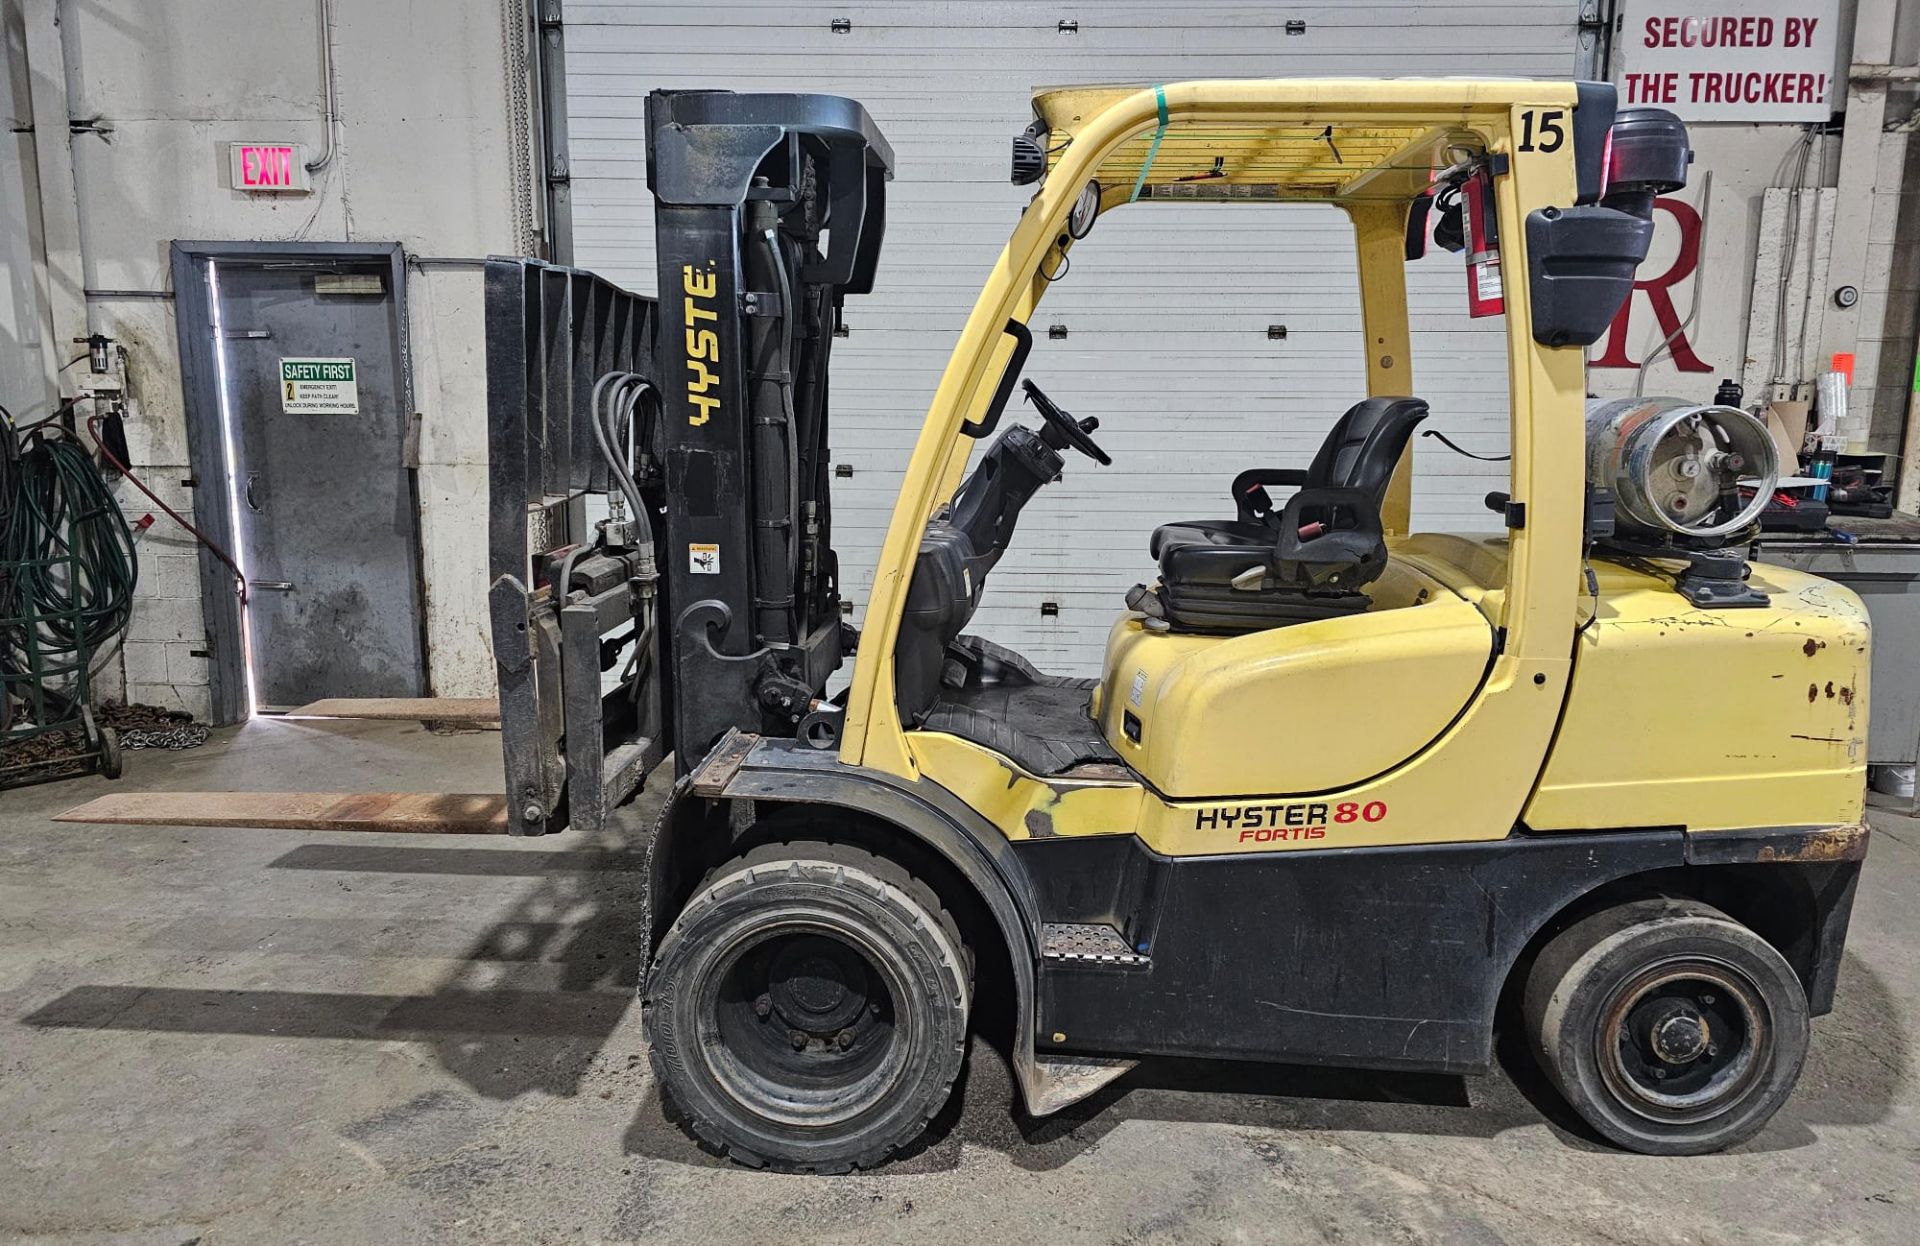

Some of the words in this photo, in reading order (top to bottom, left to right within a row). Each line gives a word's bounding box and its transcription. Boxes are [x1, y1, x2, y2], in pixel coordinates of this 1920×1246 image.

[1643, 16, 1774, 49] SECURED
[1783, 16, 1819, 48] BY
[1625, 72, 1679, 104] THE
[1689, 72, 1826, 105] TRUCKER!
[1518, 110, 1564, 153] 15
[240, 146, 292, 186] EXIT
[284, 364, 321, 379] SAFETY
[323, 364, 351, 379] FIRST
[287, 383, 294, 400] 2
[1195, 802, 1329, 830] HYSTER
[1333, 800, 1388, 824] 80
[1238, 826, 1326, 843] FORTIS
